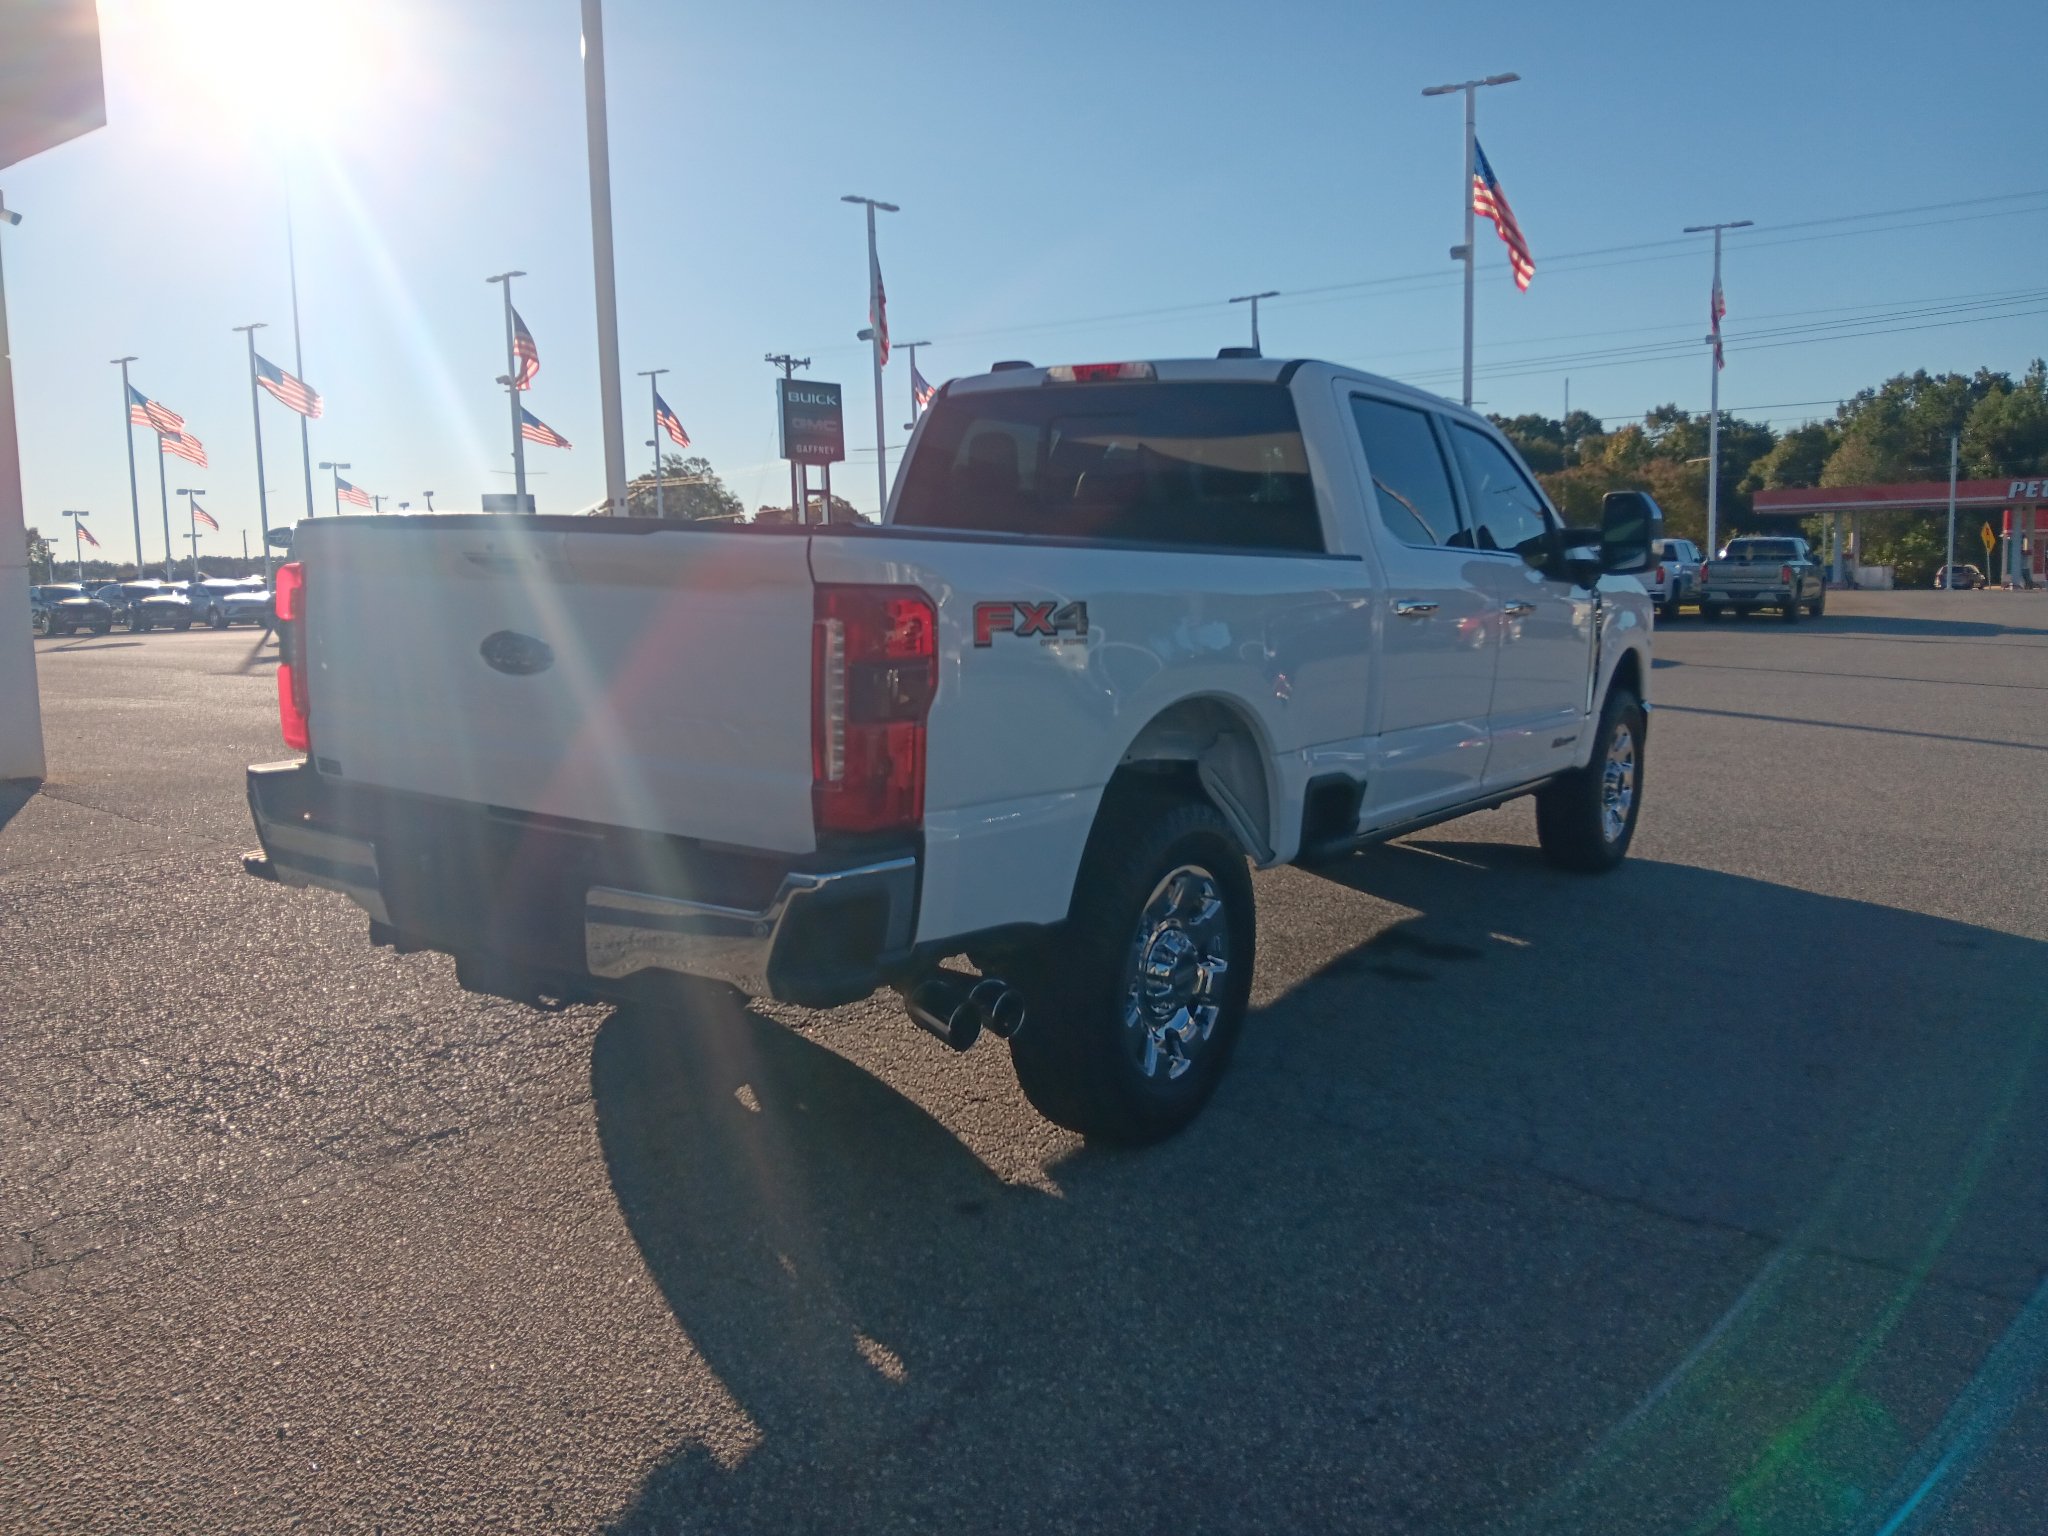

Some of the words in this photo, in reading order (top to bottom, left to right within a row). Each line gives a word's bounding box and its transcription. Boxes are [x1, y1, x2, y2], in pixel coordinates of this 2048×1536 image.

[787, 391, 838, 405] BUICK
[791, 418, 837, 432] GMC
[796, 444, 836, 455] GAFFNEY
[973, 601, 1088, 648] FX4
